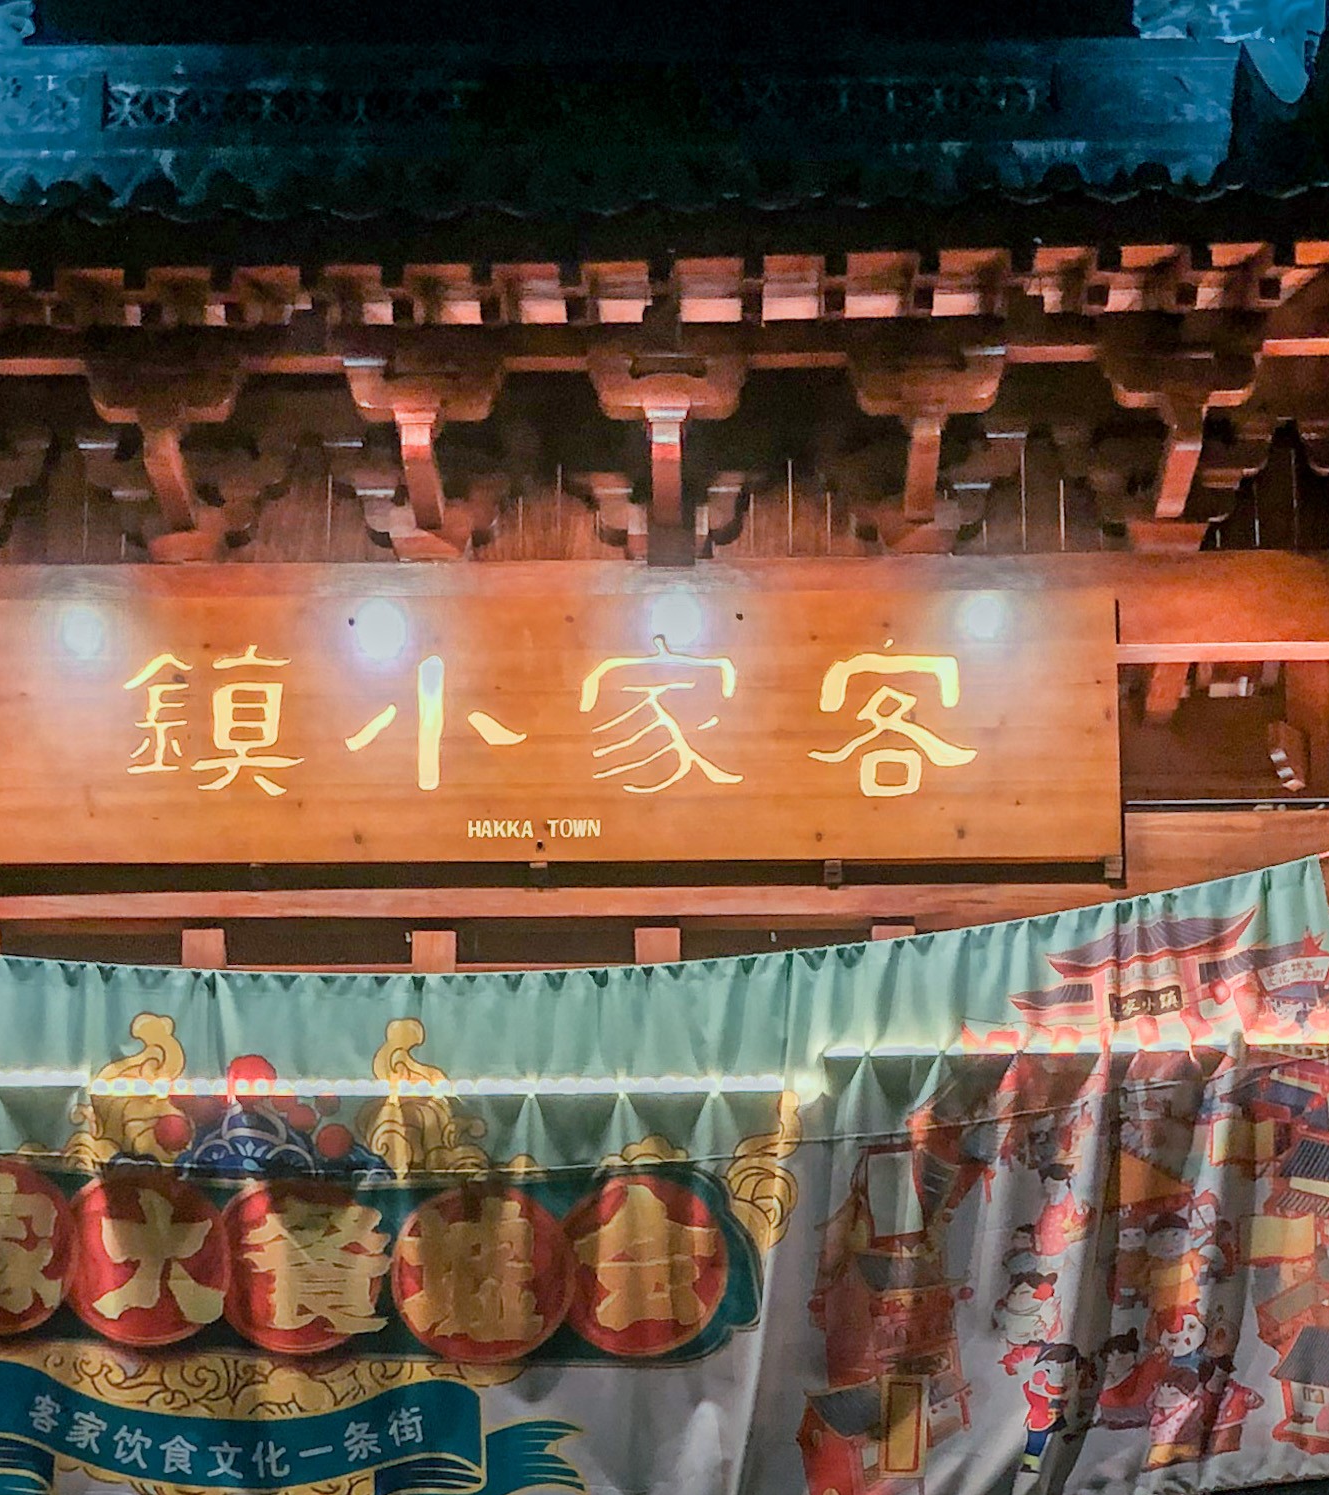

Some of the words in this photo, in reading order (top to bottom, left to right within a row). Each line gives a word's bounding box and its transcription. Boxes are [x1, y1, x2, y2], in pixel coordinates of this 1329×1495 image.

[467, 819, 534, 839] HAKKA
[546, 818, 601, 838] TOWN
[29, 1393, 425, 1480] 客家饮食文化一条街
